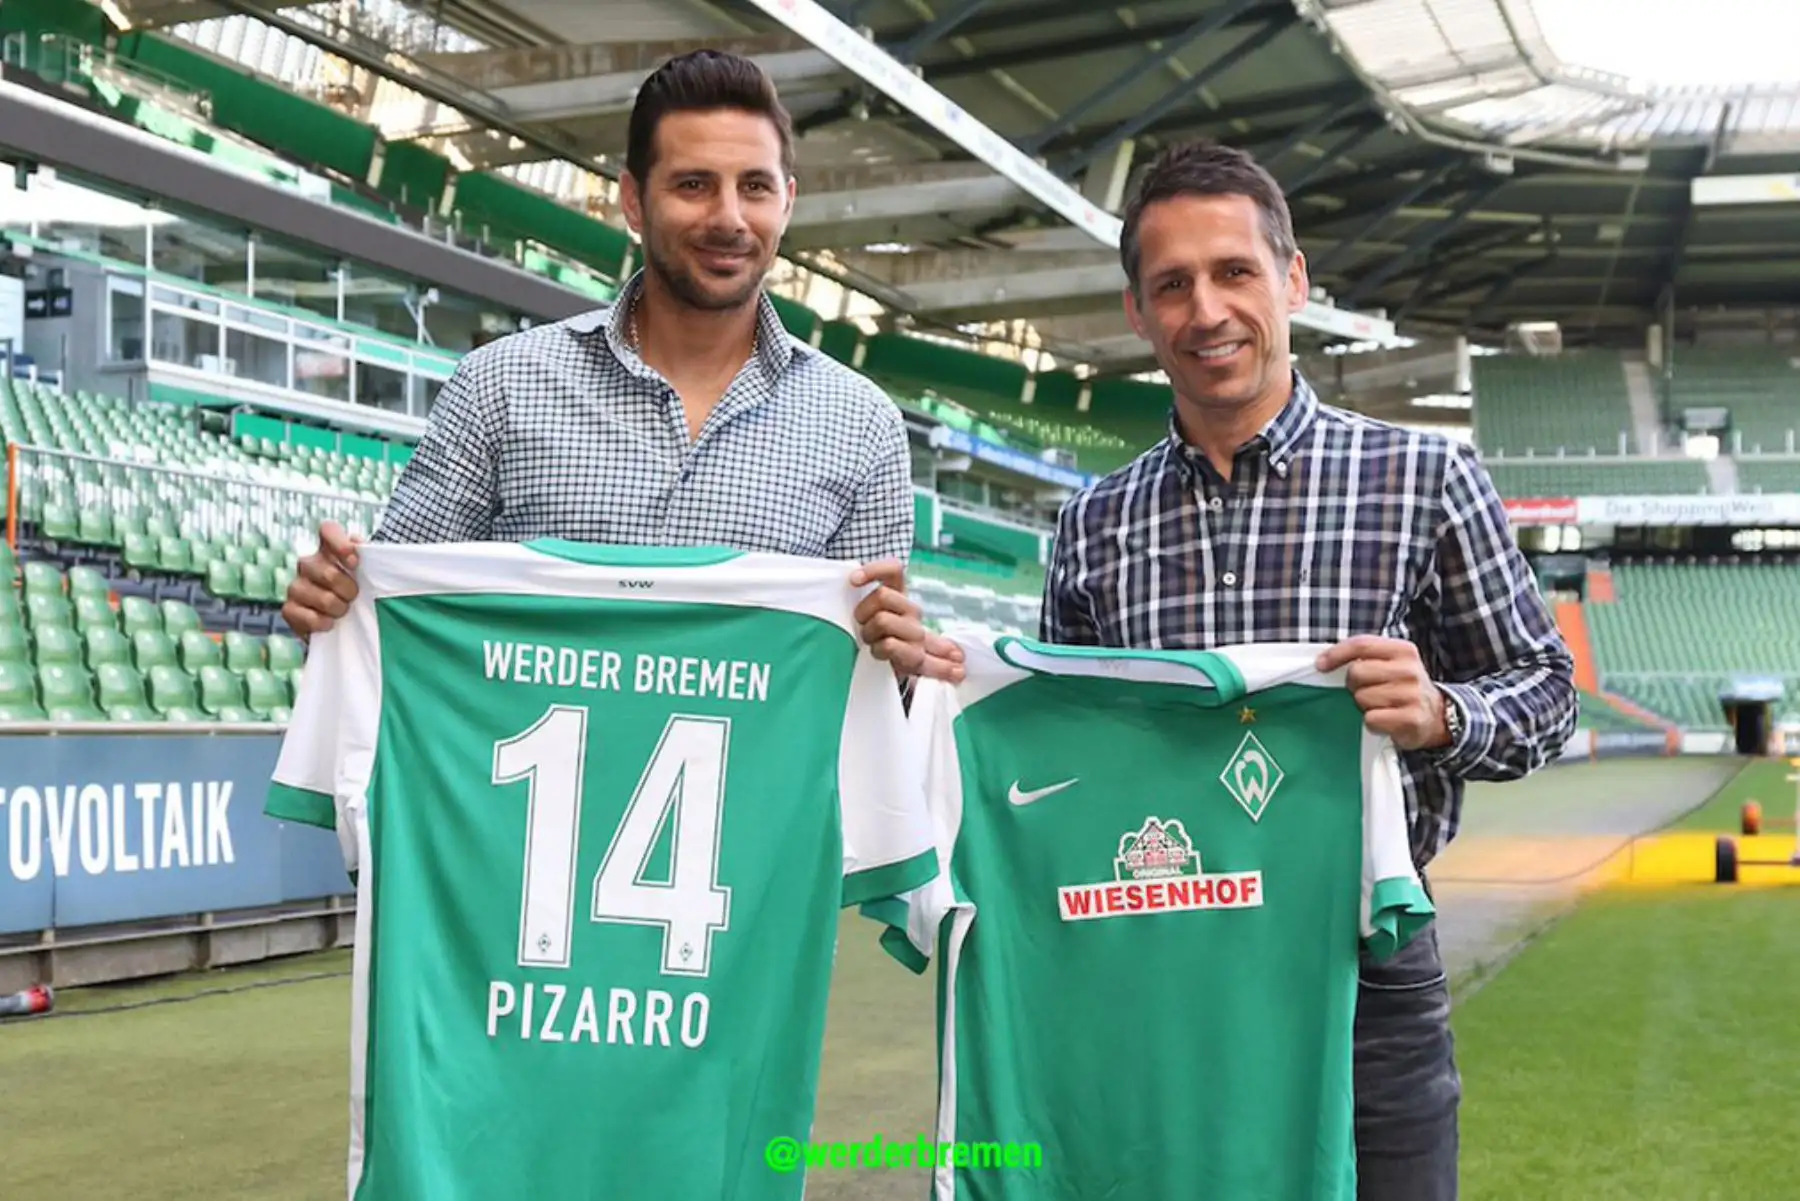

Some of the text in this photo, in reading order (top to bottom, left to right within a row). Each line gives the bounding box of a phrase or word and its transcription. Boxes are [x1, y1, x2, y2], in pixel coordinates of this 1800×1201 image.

[483, 640, 771, 702] WERDER BREMEN
[0, 781, 235, 881] OVOLTAIK
[491, 703, 732, 978] 14
[1063, 878, 1257, 917] WIESENHOF
[486, 980, 711, 1048] PIZARRO
